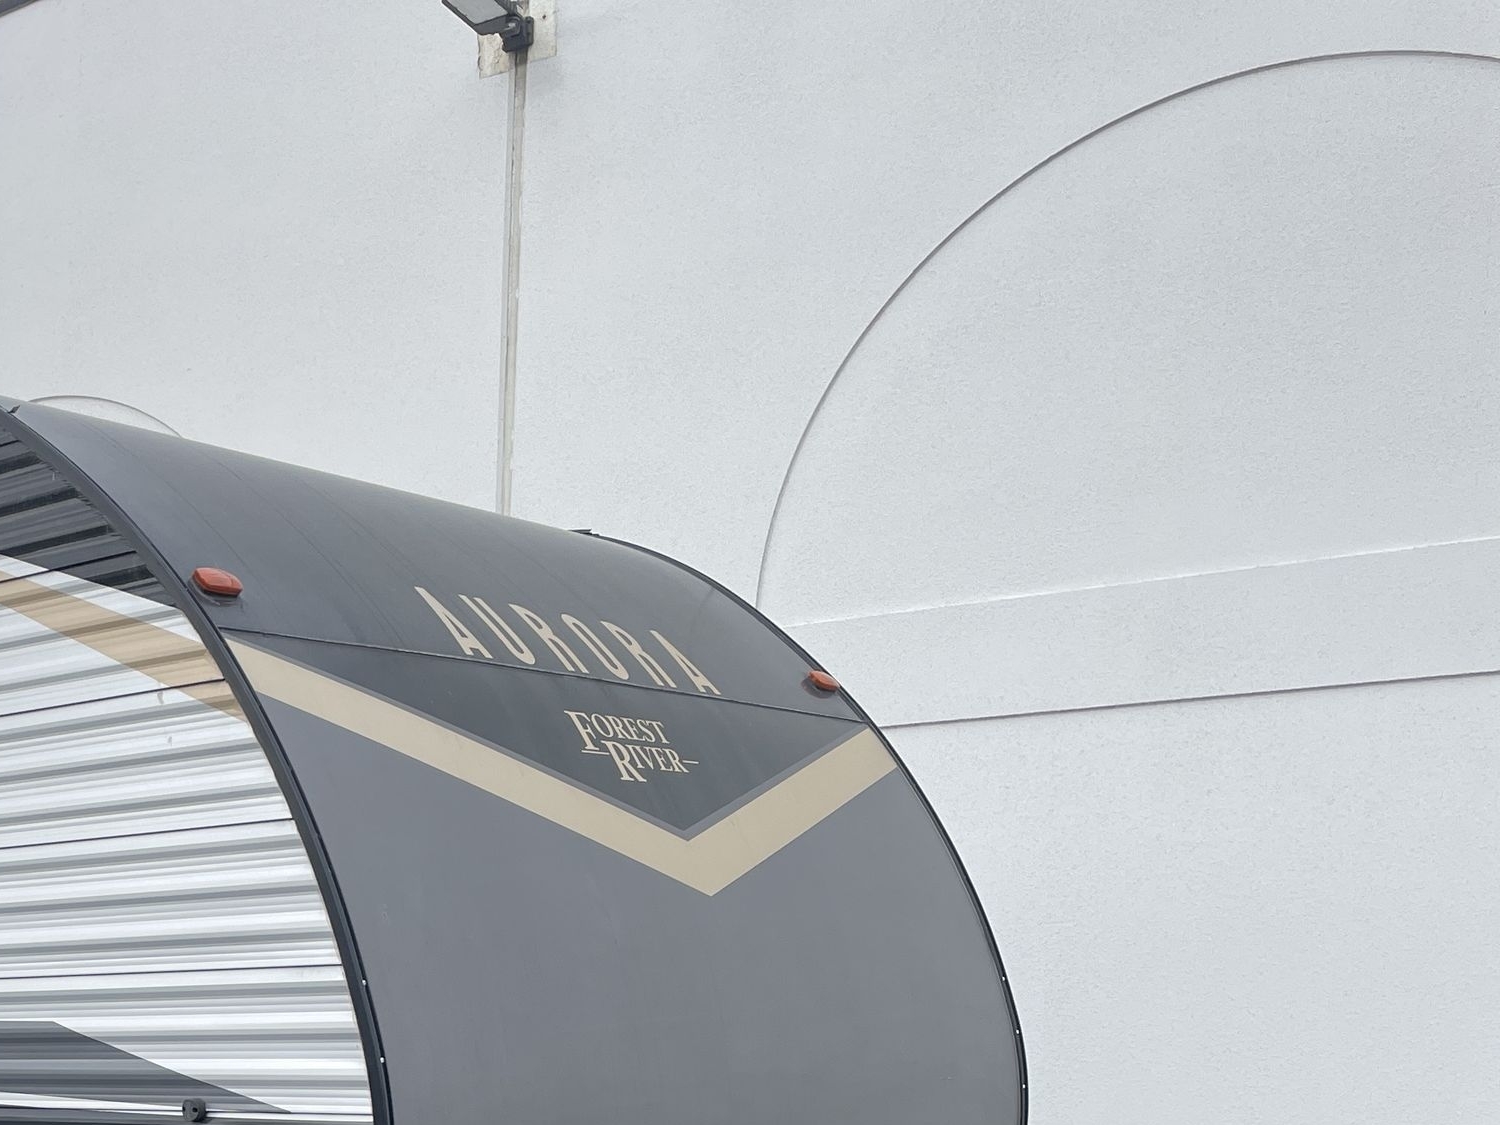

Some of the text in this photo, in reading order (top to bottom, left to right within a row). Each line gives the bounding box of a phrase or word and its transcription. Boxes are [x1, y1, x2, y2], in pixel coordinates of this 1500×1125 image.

[414, 586, 720, 695] AURORA
[564, 710, 670, 751] FOREST
[601, 740, 689, 782] RIVER
